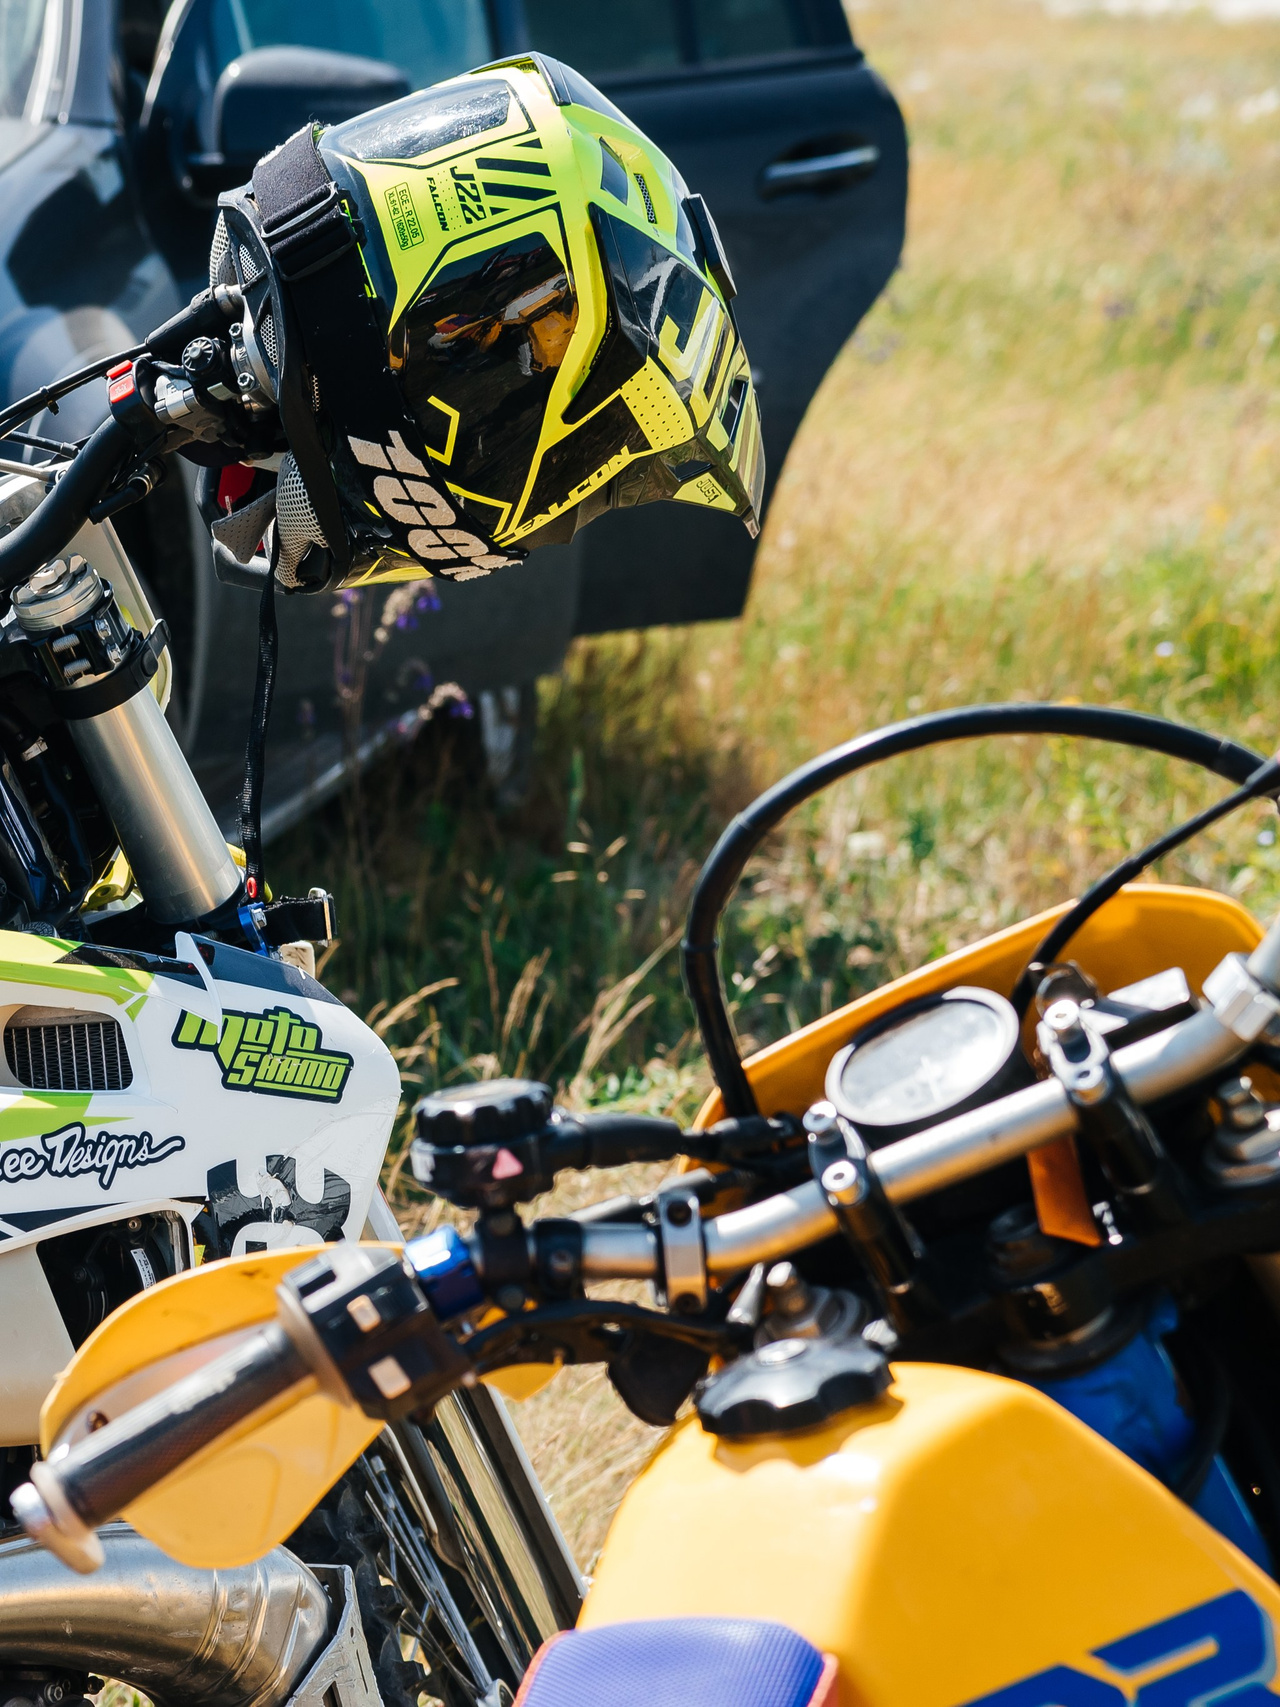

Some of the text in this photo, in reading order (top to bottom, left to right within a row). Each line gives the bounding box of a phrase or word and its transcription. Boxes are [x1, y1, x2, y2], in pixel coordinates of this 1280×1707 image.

[398, 188, 410, 206] ECE
[426, 177, 450, 232] FALCON
[449, 165, 487, 225] J22
[41, 1122, 185, 1190] Designs
